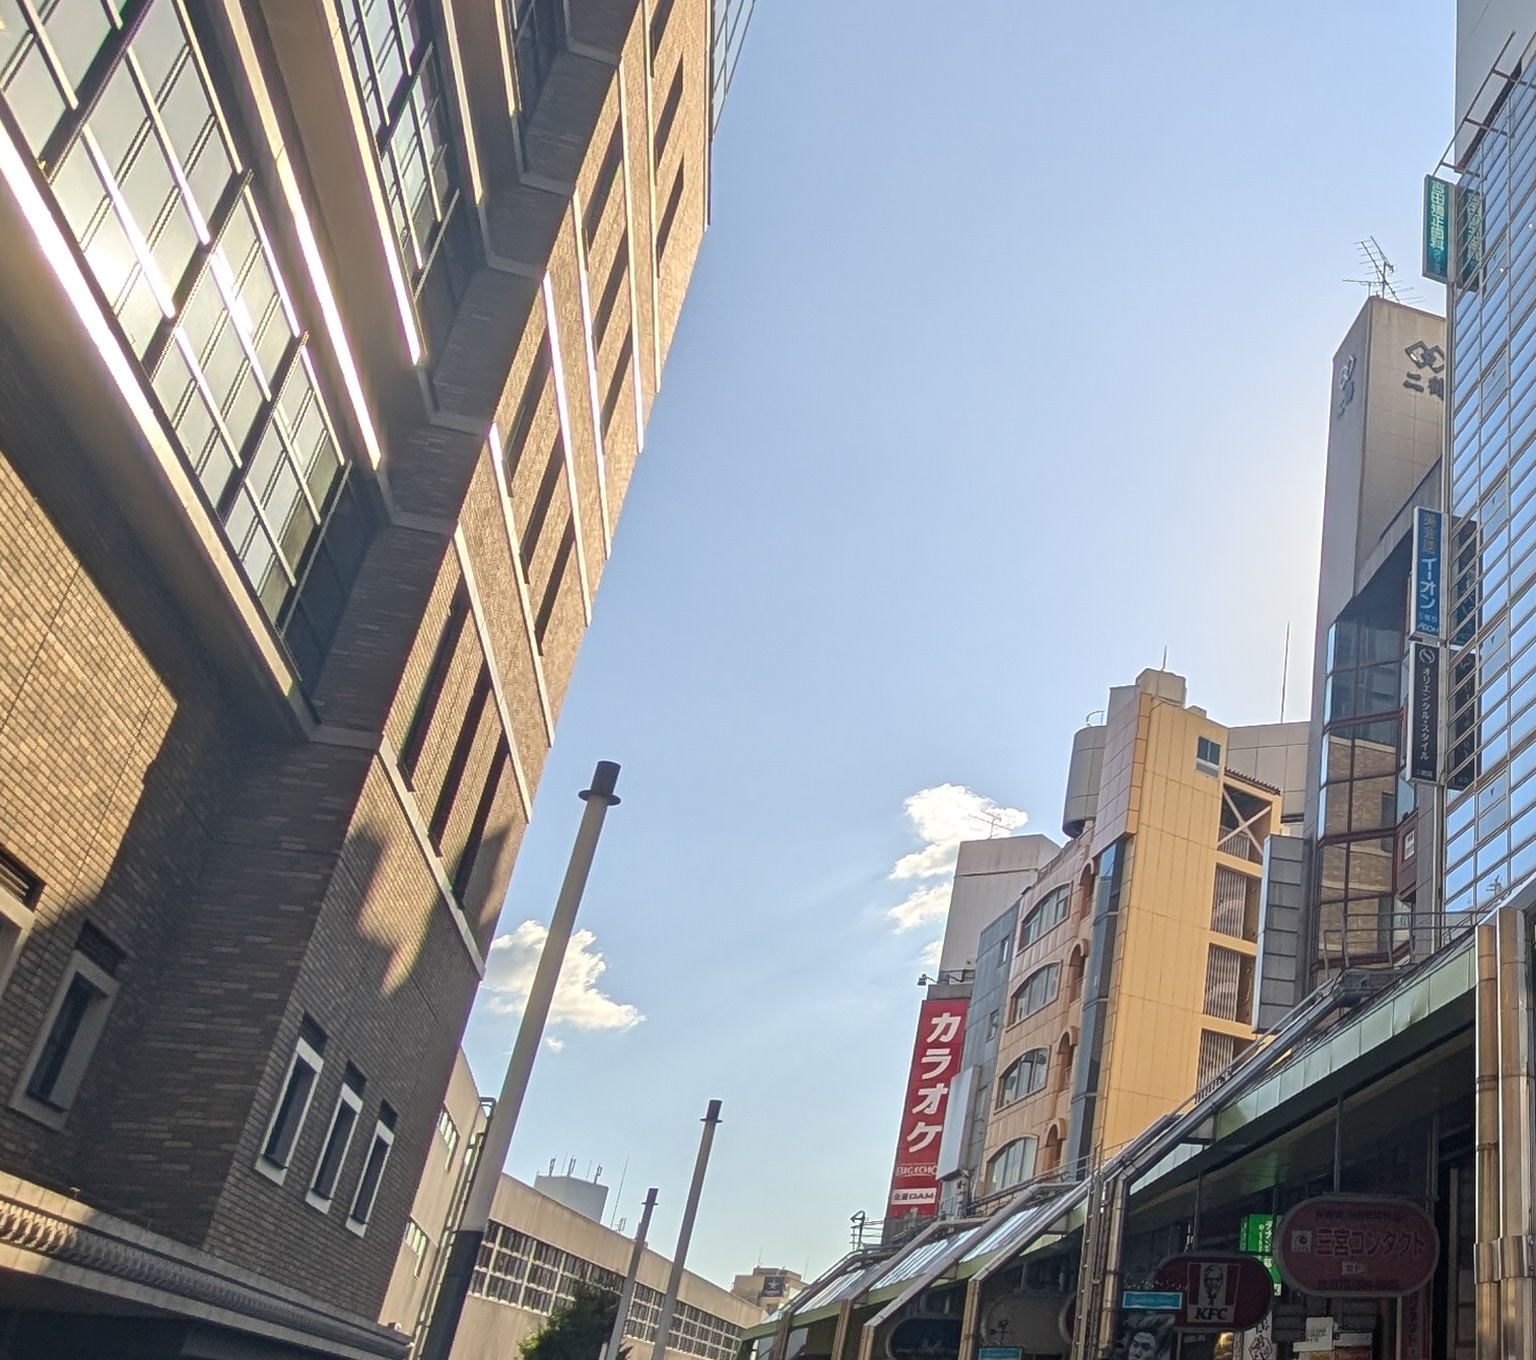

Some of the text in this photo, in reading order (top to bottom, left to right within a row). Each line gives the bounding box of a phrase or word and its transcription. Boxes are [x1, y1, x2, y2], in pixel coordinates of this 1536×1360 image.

[1420, 557, 1437, 609] イーオン
[907, 1012, 961, 1154] カラオケ
[1316, 1227, 1425, 1259] 三宮コンタクト
[1195, 1307, 1228, 1320] KFC
